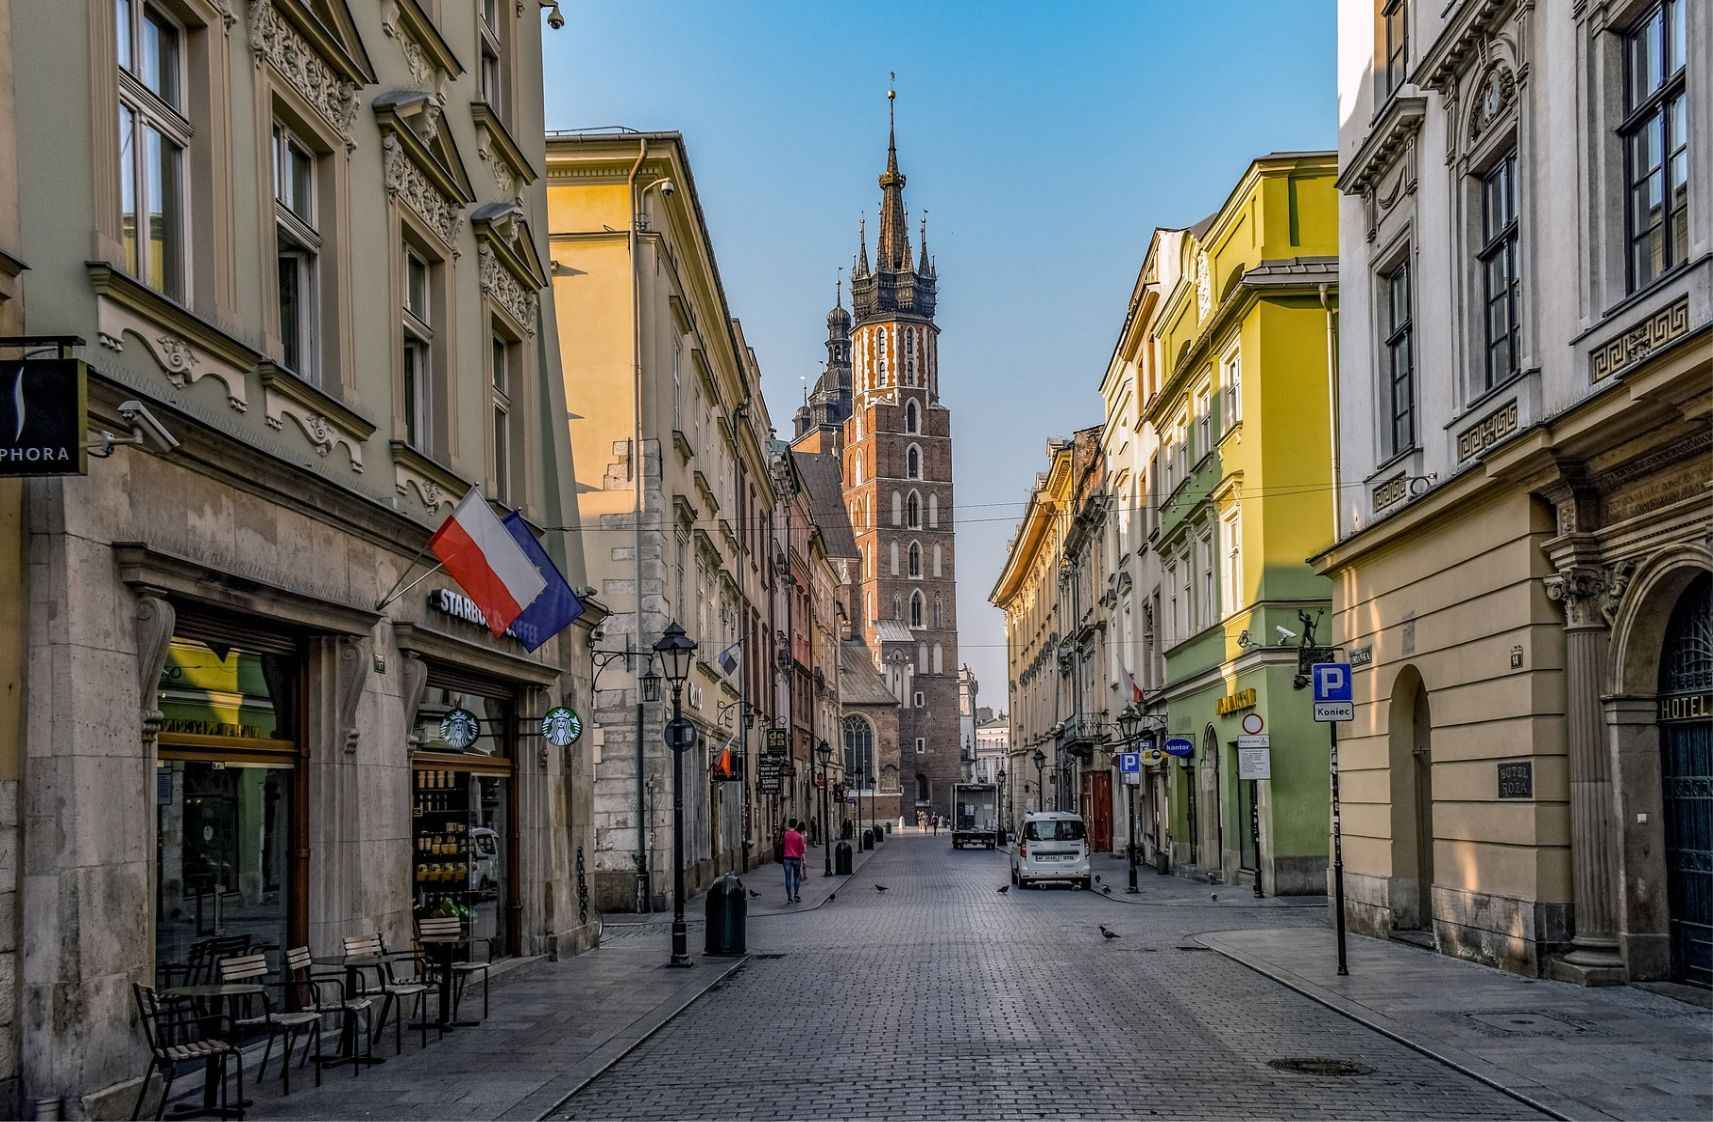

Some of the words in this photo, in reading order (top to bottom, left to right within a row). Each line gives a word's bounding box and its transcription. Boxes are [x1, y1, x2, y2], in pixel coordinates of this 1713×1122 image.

[1321, 667, 1344, 697] P
[1317, 708, 1351, 716] Koniec
[1661, 696, 1709, 719] HOTEL
[1124, 755, 1136, 770] P
